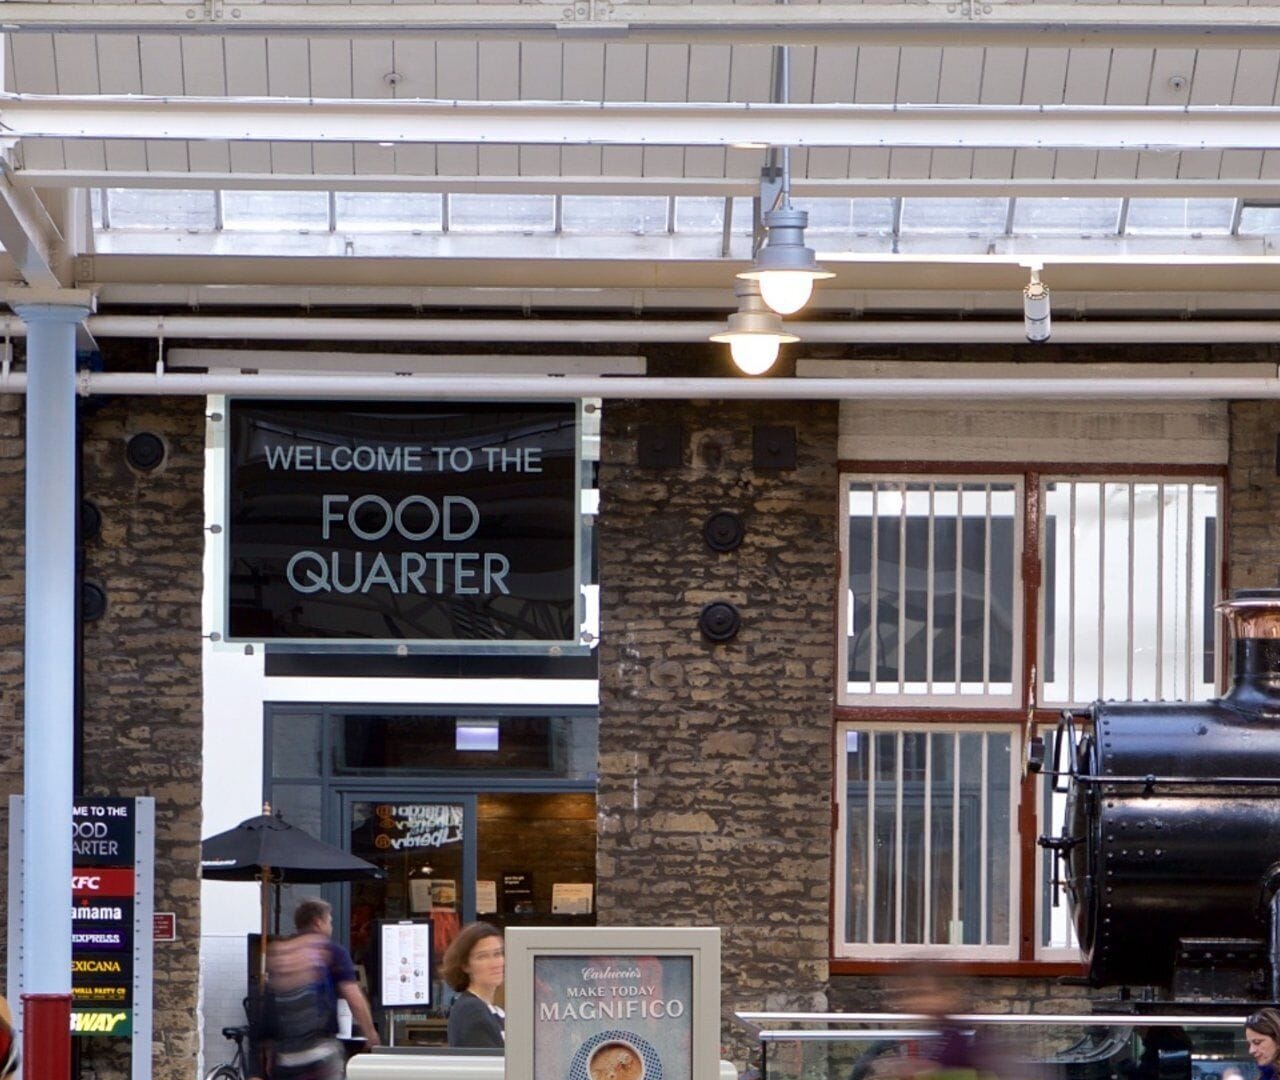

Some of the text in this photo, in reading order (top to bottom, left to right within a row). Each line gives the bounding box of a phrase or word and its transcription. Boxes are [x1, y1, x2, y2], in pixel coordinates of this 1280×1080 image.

[265, 445, 543, 473] WELCOME TO THE
[322, 494, 480, 541] FOOD
[286, 550, 510, 594] QUARTER
[90, 806, 105, 816] TO
[107, 806, 128, 817] THE
[73, 841, 118, 855] ARTER
[71, 907, 122, 919] amama
[71, 961, 121, 972] EXICANA
[581, 966, 642, 981] Carluccio's
[567, 985, 655, 997] MAKE TODAY
[540, 999, 684, 1021] MAGNIFICO
[70, 1012, 127, 1032] BWAY
